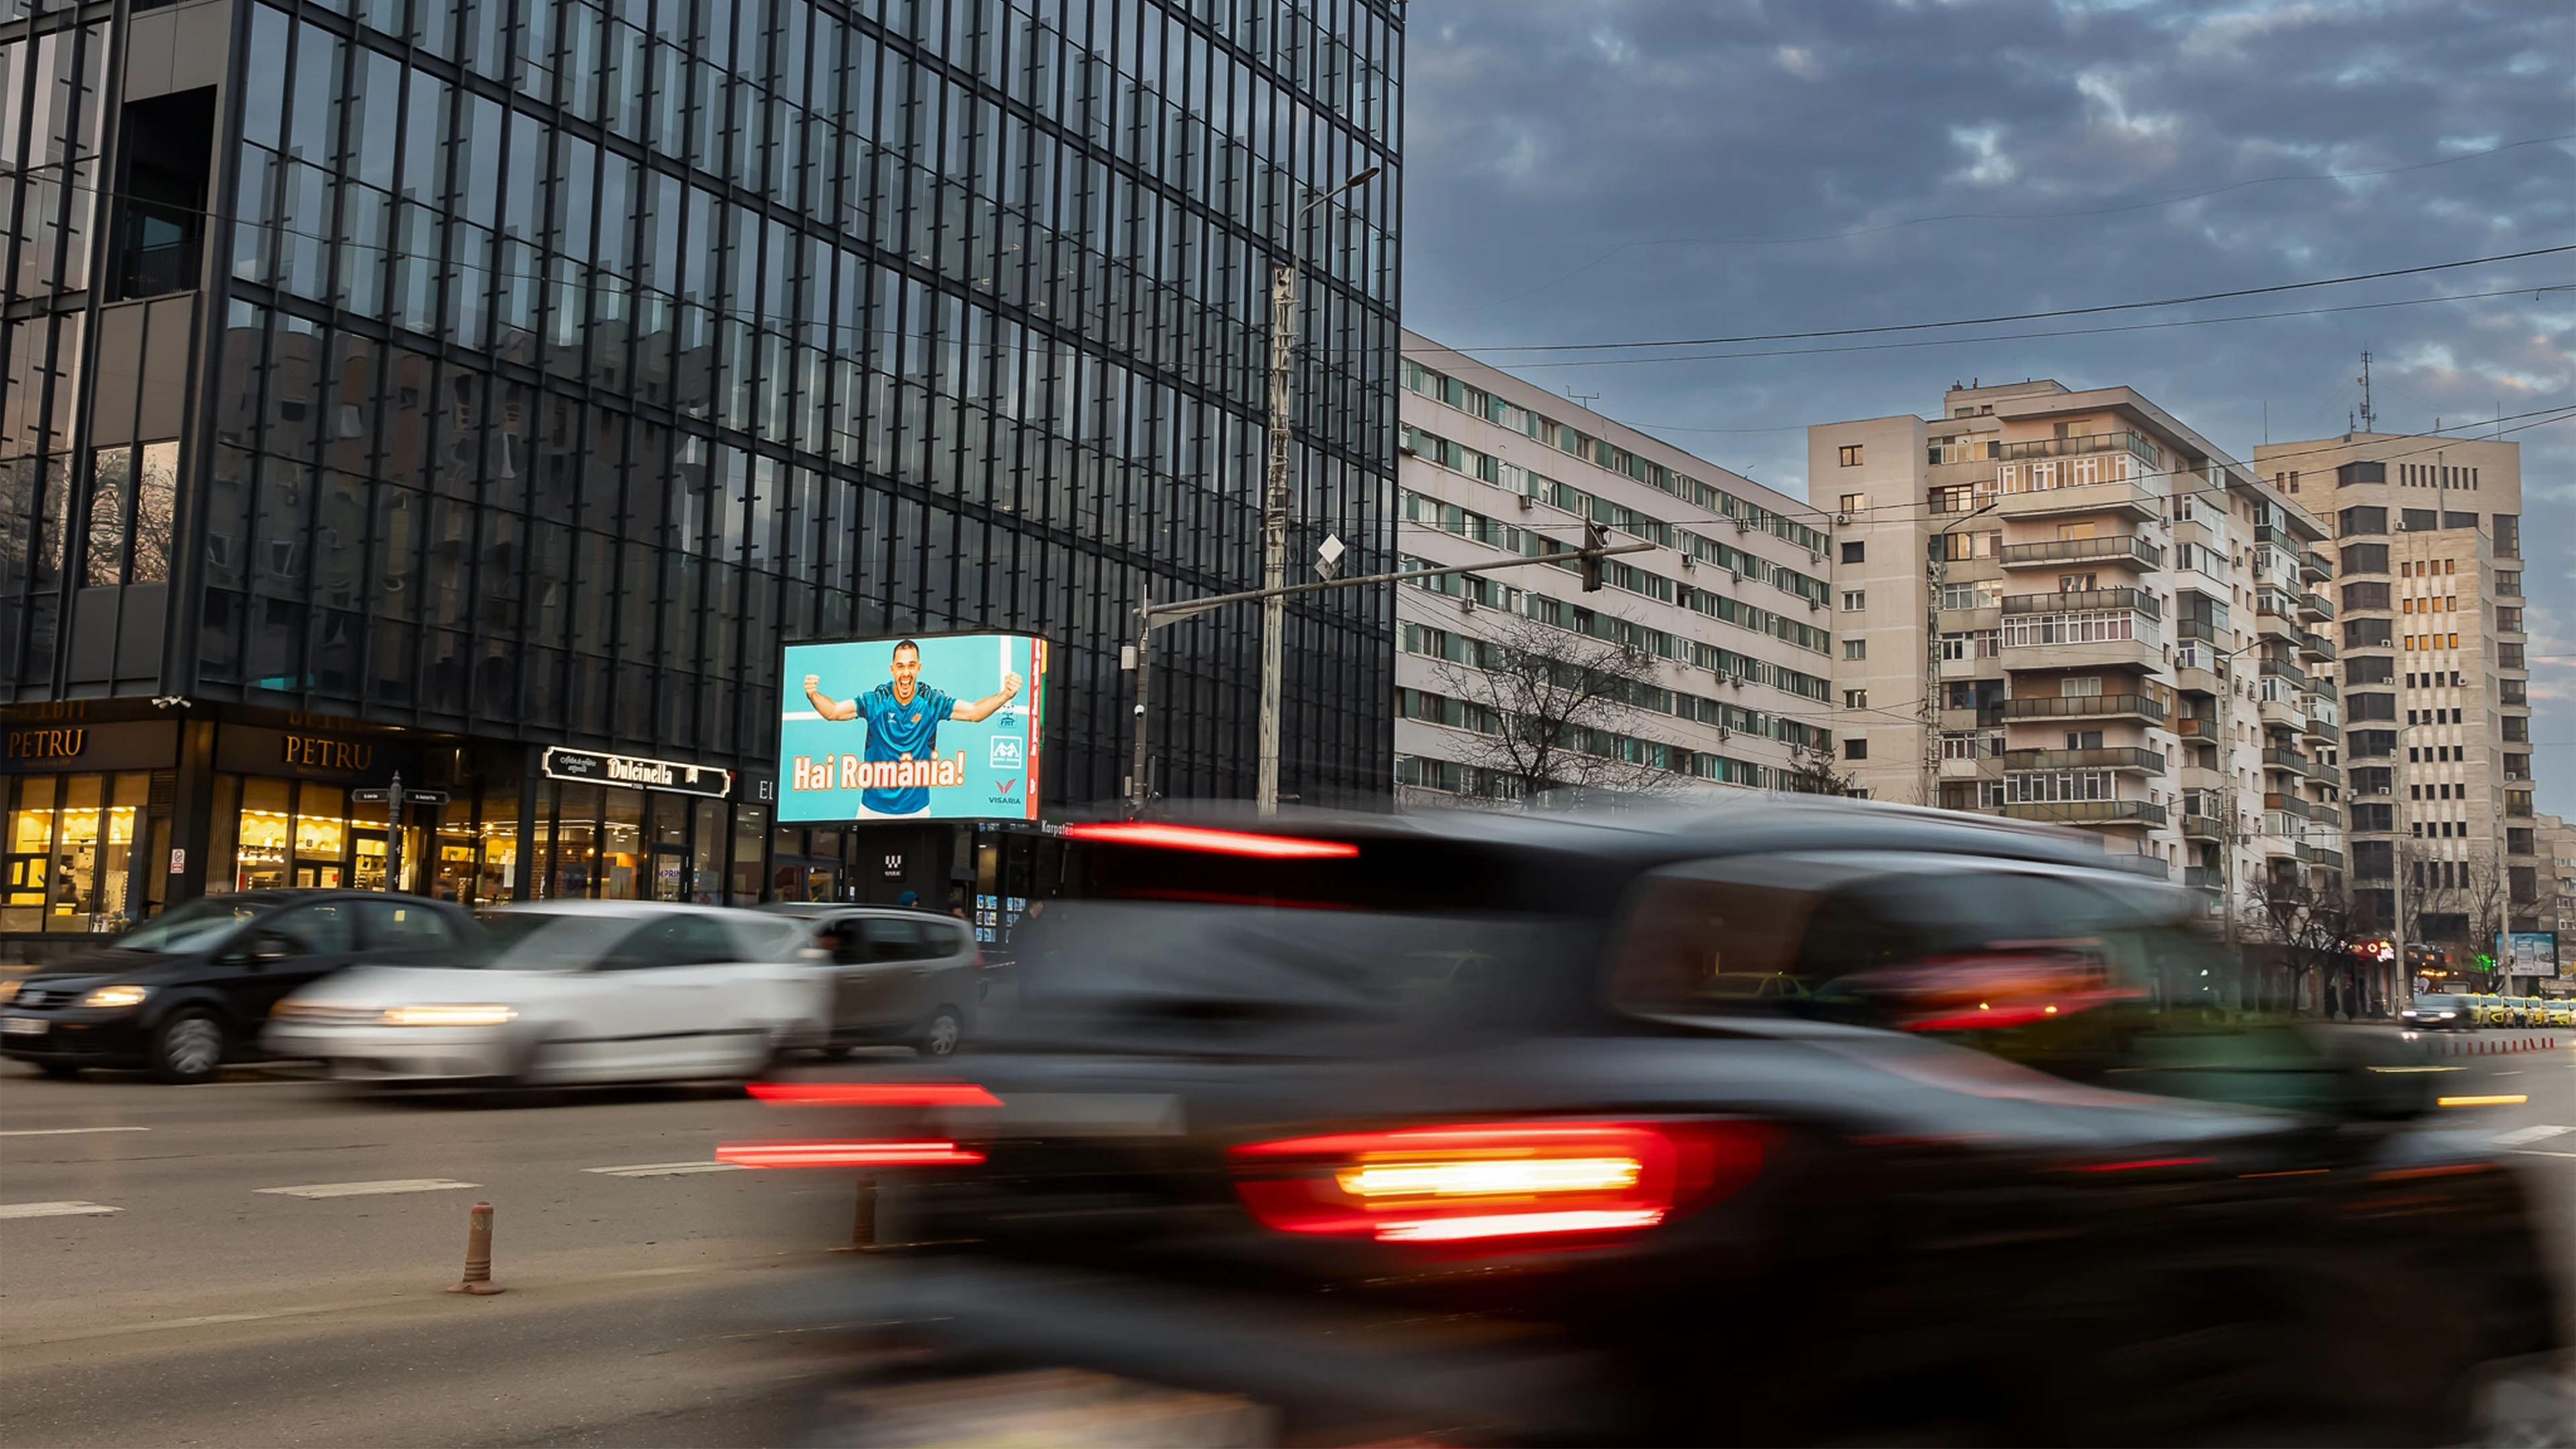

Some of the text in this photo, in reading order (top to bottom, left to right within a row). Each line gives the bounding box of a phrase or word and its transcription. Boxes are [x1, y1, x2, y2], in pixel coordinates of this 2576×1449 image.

[8, 729, 83, 758] PETRU
[286, 735, 372, 770] PETRU
[607, 757, 672, 785] Dulcinella
[793, 753, 835, 791] Hai
[840, 750, 965, 790] România!
